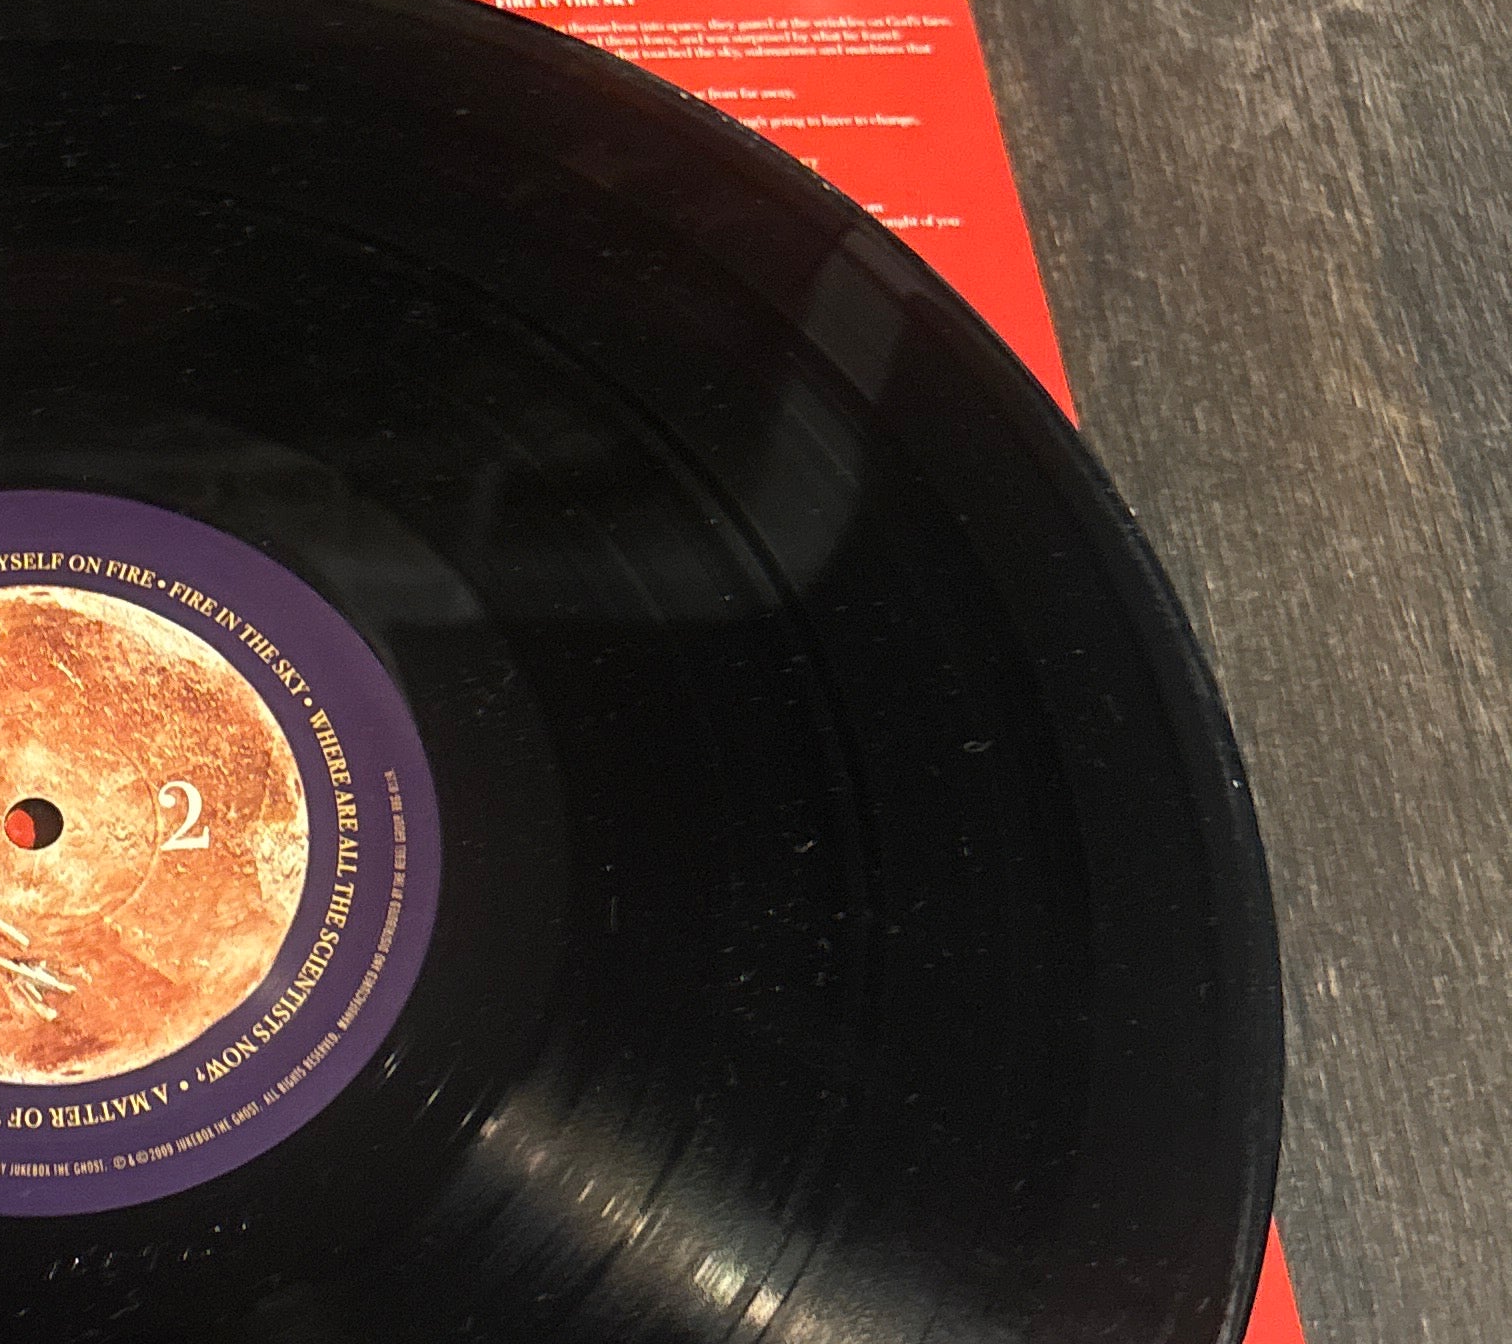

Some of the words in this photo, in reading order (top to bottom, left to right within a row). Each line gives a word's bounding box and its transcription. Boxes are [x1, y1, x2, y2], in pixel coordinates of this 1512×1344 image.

[68, 554, 102, 574] ON
[106, 560, 156, 590] FIRE
[167, 580, 217, 618] FIRE
[214, 607, 243, 632] IN
[238, 623, 279, 665] THE
[272, 656, 311, 698] SKY
[309, 709, 351, 787] WHERE
[157, 780, 211, 851] 2
[335, 789, 359, 832] ARE
[336, 834, 359, 877] ALL
[325, 882, 355, 929] THE
[252, 928, 340, 1044] SCIENTISTS
[195, 1034, 259, 1083] NOW?
[51, 1090, 152, 1128] MATTER
[150, 1083, 169, 1105] A
[7, 1107, 43, 1129] OF
[9, 1163, 51, 1177] JUKEBOX
[53, 1163, 71, 1176] THE
[73, 1158, 108, 1176] GHOST.
[175, 1126, 216, 1153] JUKEBOX
[213, 1117, 233, 1135] THE
[234, 1101, 263, 1127] GHOST.
[263, 1088, 281, 1106] ALL
[276, 1065, 307, 1095] RIGHTS
